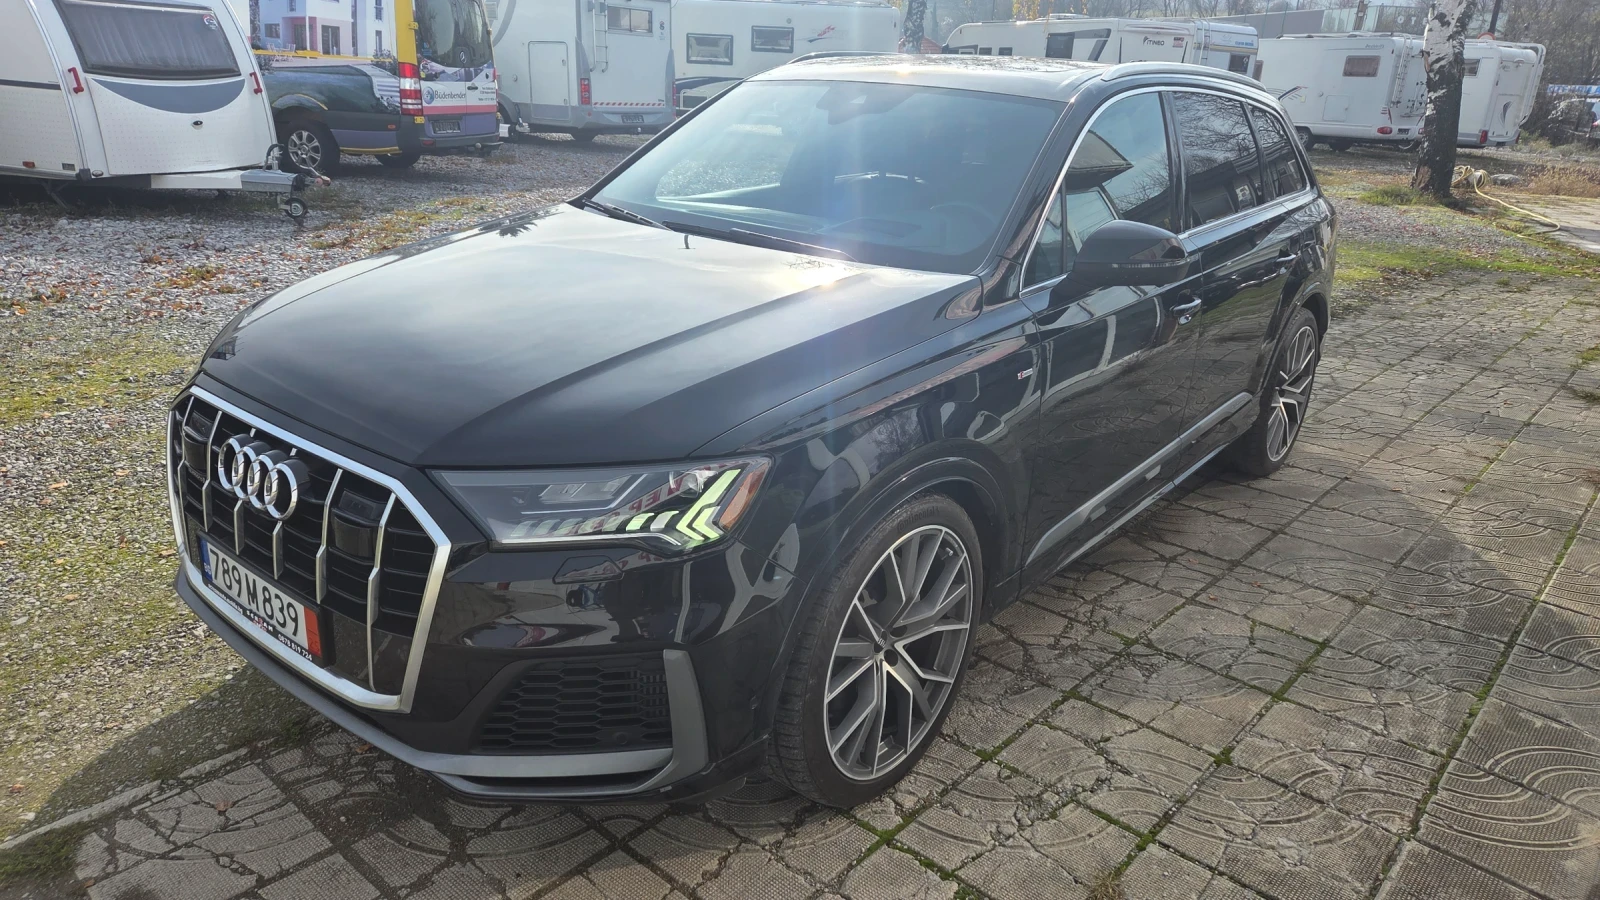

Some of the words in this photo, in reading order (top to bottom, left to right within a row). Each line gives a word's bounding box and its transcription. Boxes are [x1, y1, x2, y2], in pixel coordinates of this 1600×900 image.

[434, 90, 466, 100] Büdenbender
[209, 547, 242, 598] 789
[245, 572, 260, 612] M
[262, 585, 299, 637] 839
